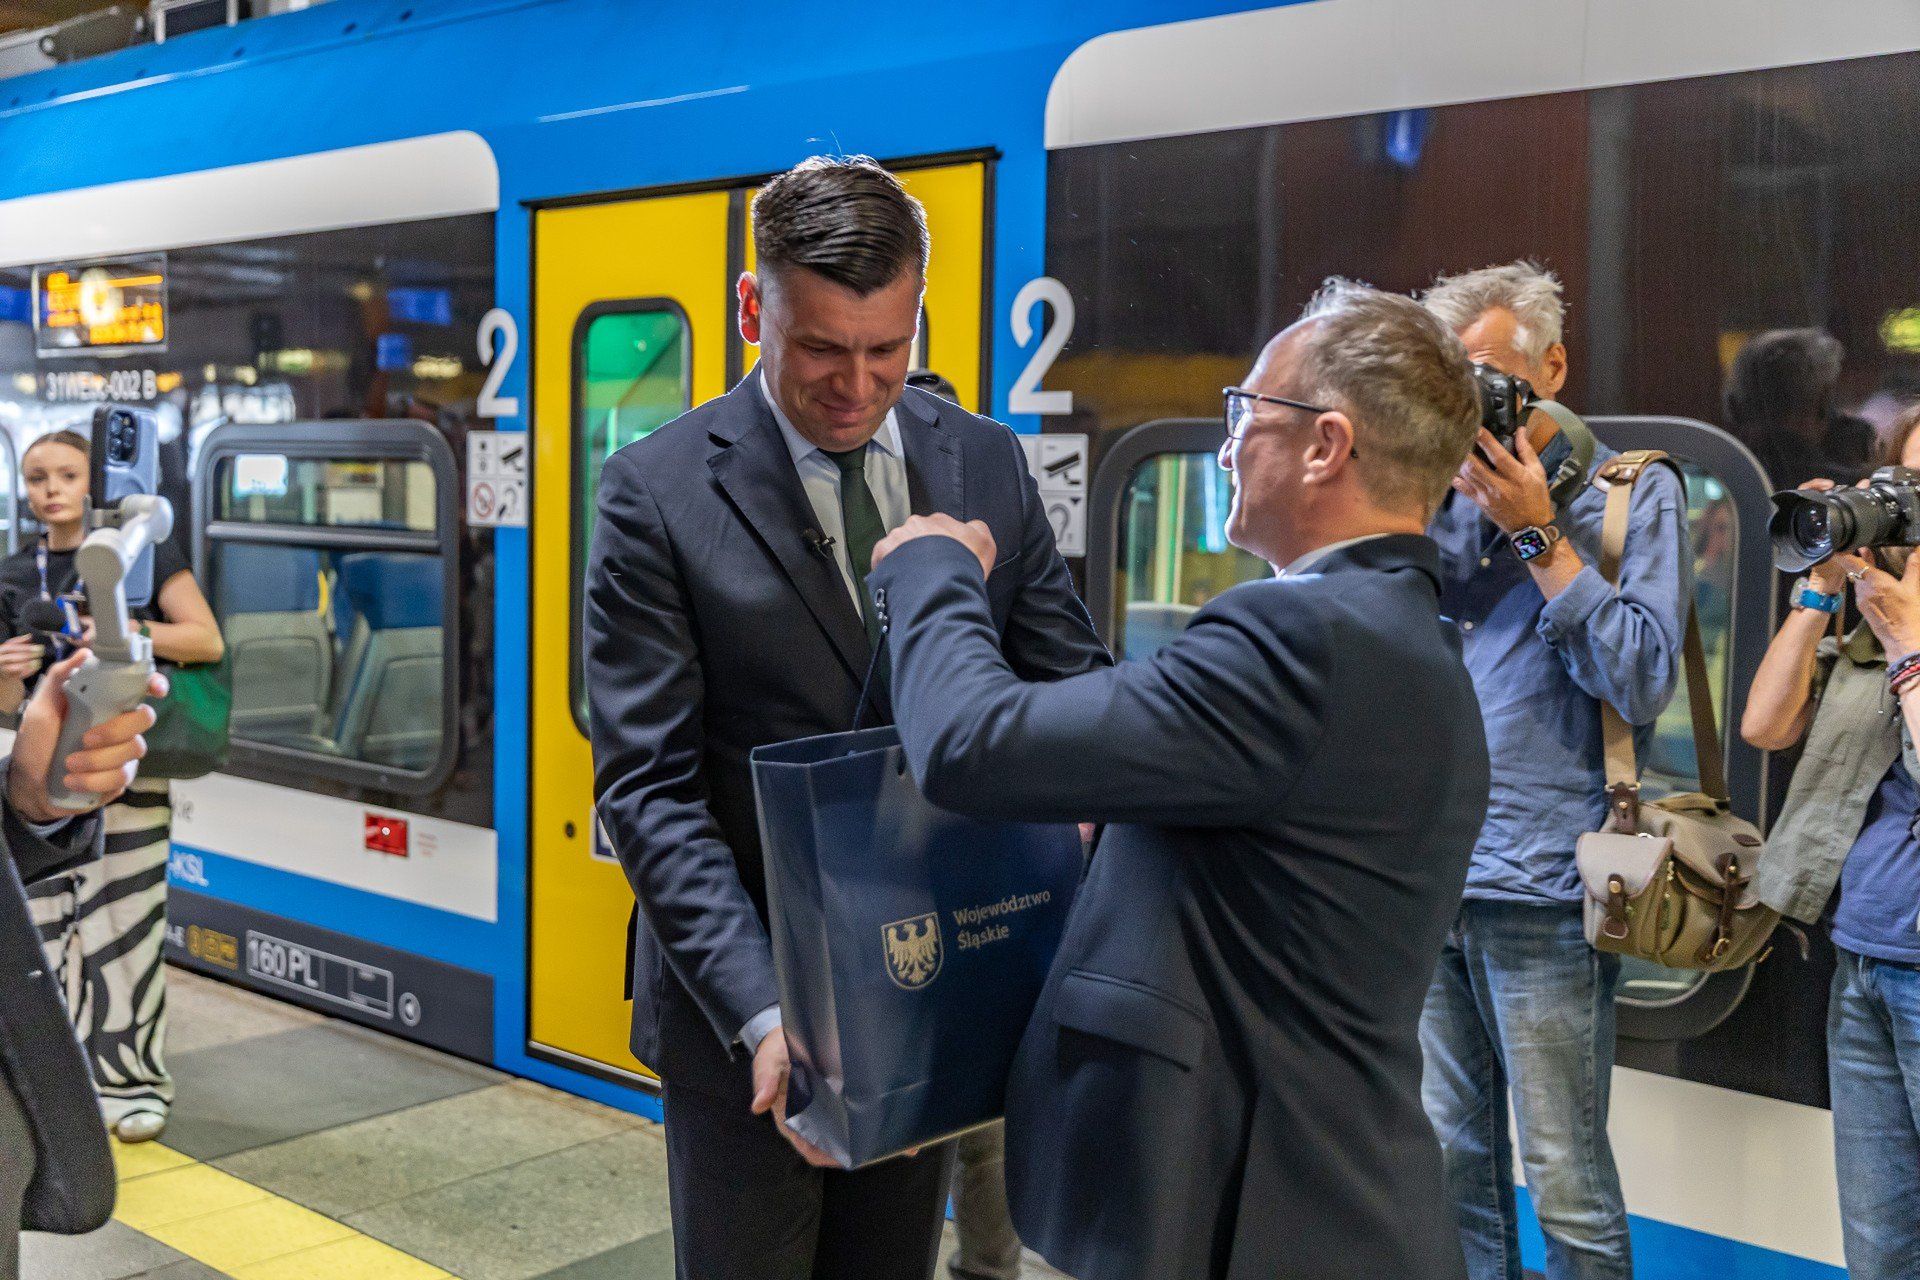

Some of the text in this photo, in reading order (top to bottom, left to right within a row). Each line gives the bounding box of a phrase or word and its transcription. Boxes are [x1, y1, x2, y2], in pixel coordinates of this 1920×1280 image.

[476, 308, 519, 418] 2
[1008, 277, 1075, 415] 2
[953, 890, 1051, 925] Województwo
[957, 925, 1010, 949] Śląskie
